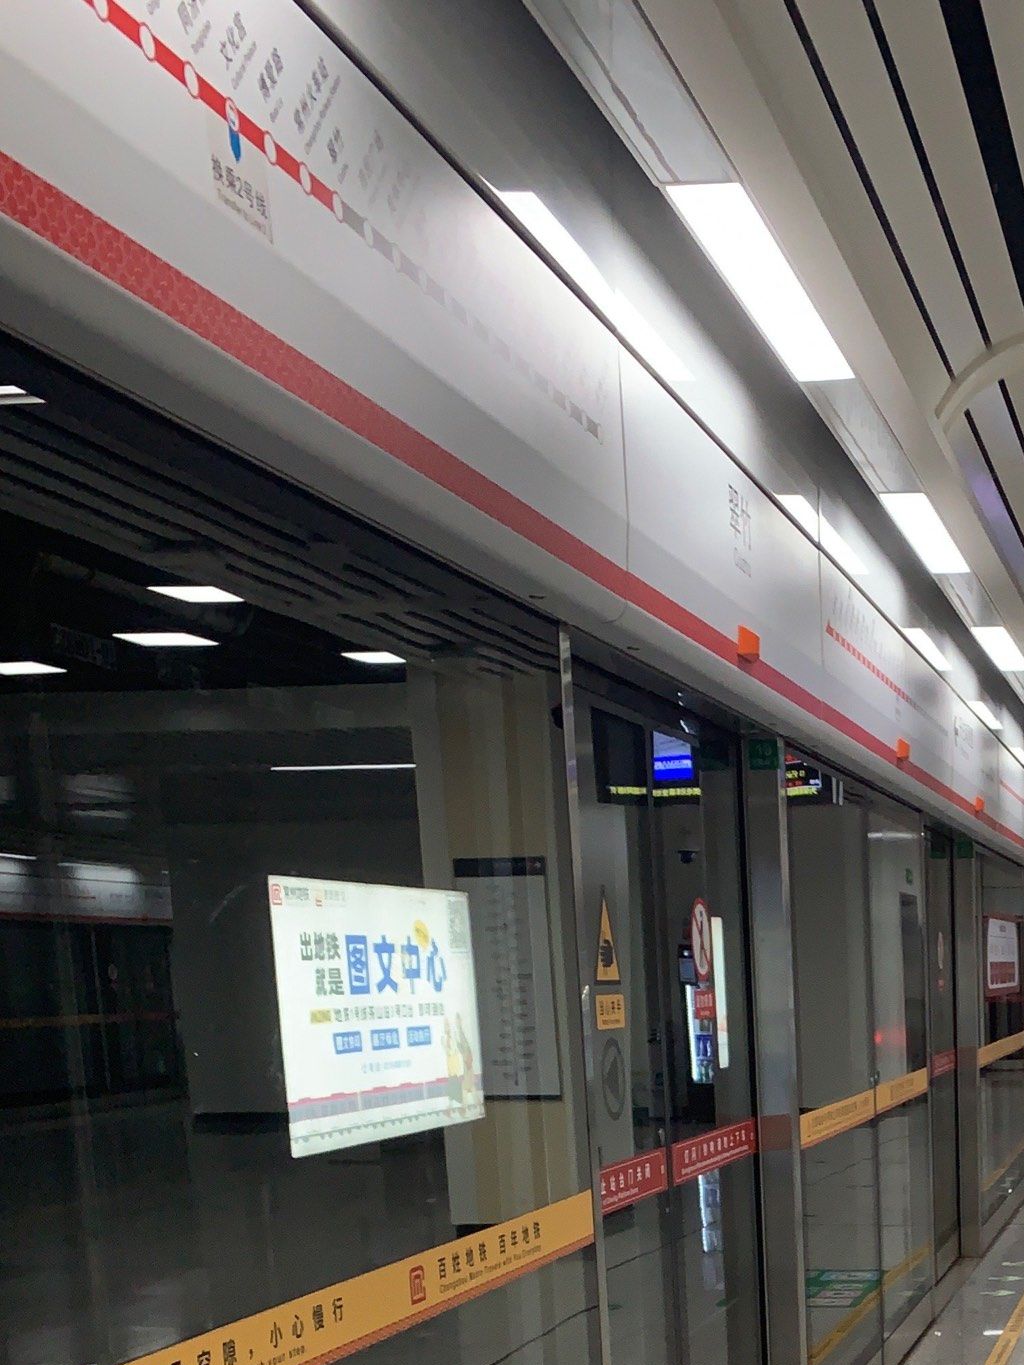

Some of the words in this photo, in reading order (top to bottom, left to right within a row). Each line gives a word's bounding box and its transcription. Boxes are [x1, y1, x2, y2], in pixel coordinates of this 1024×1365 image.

[300, 932, 341, 961] 出地铁
[345, 934, 447, 994] 图文中心
[315, 967, 345, 996] 就是
[438, 1241, 487, 1279] 百姓地铁
[498, 1222, 541, 1254] 百年地铁
